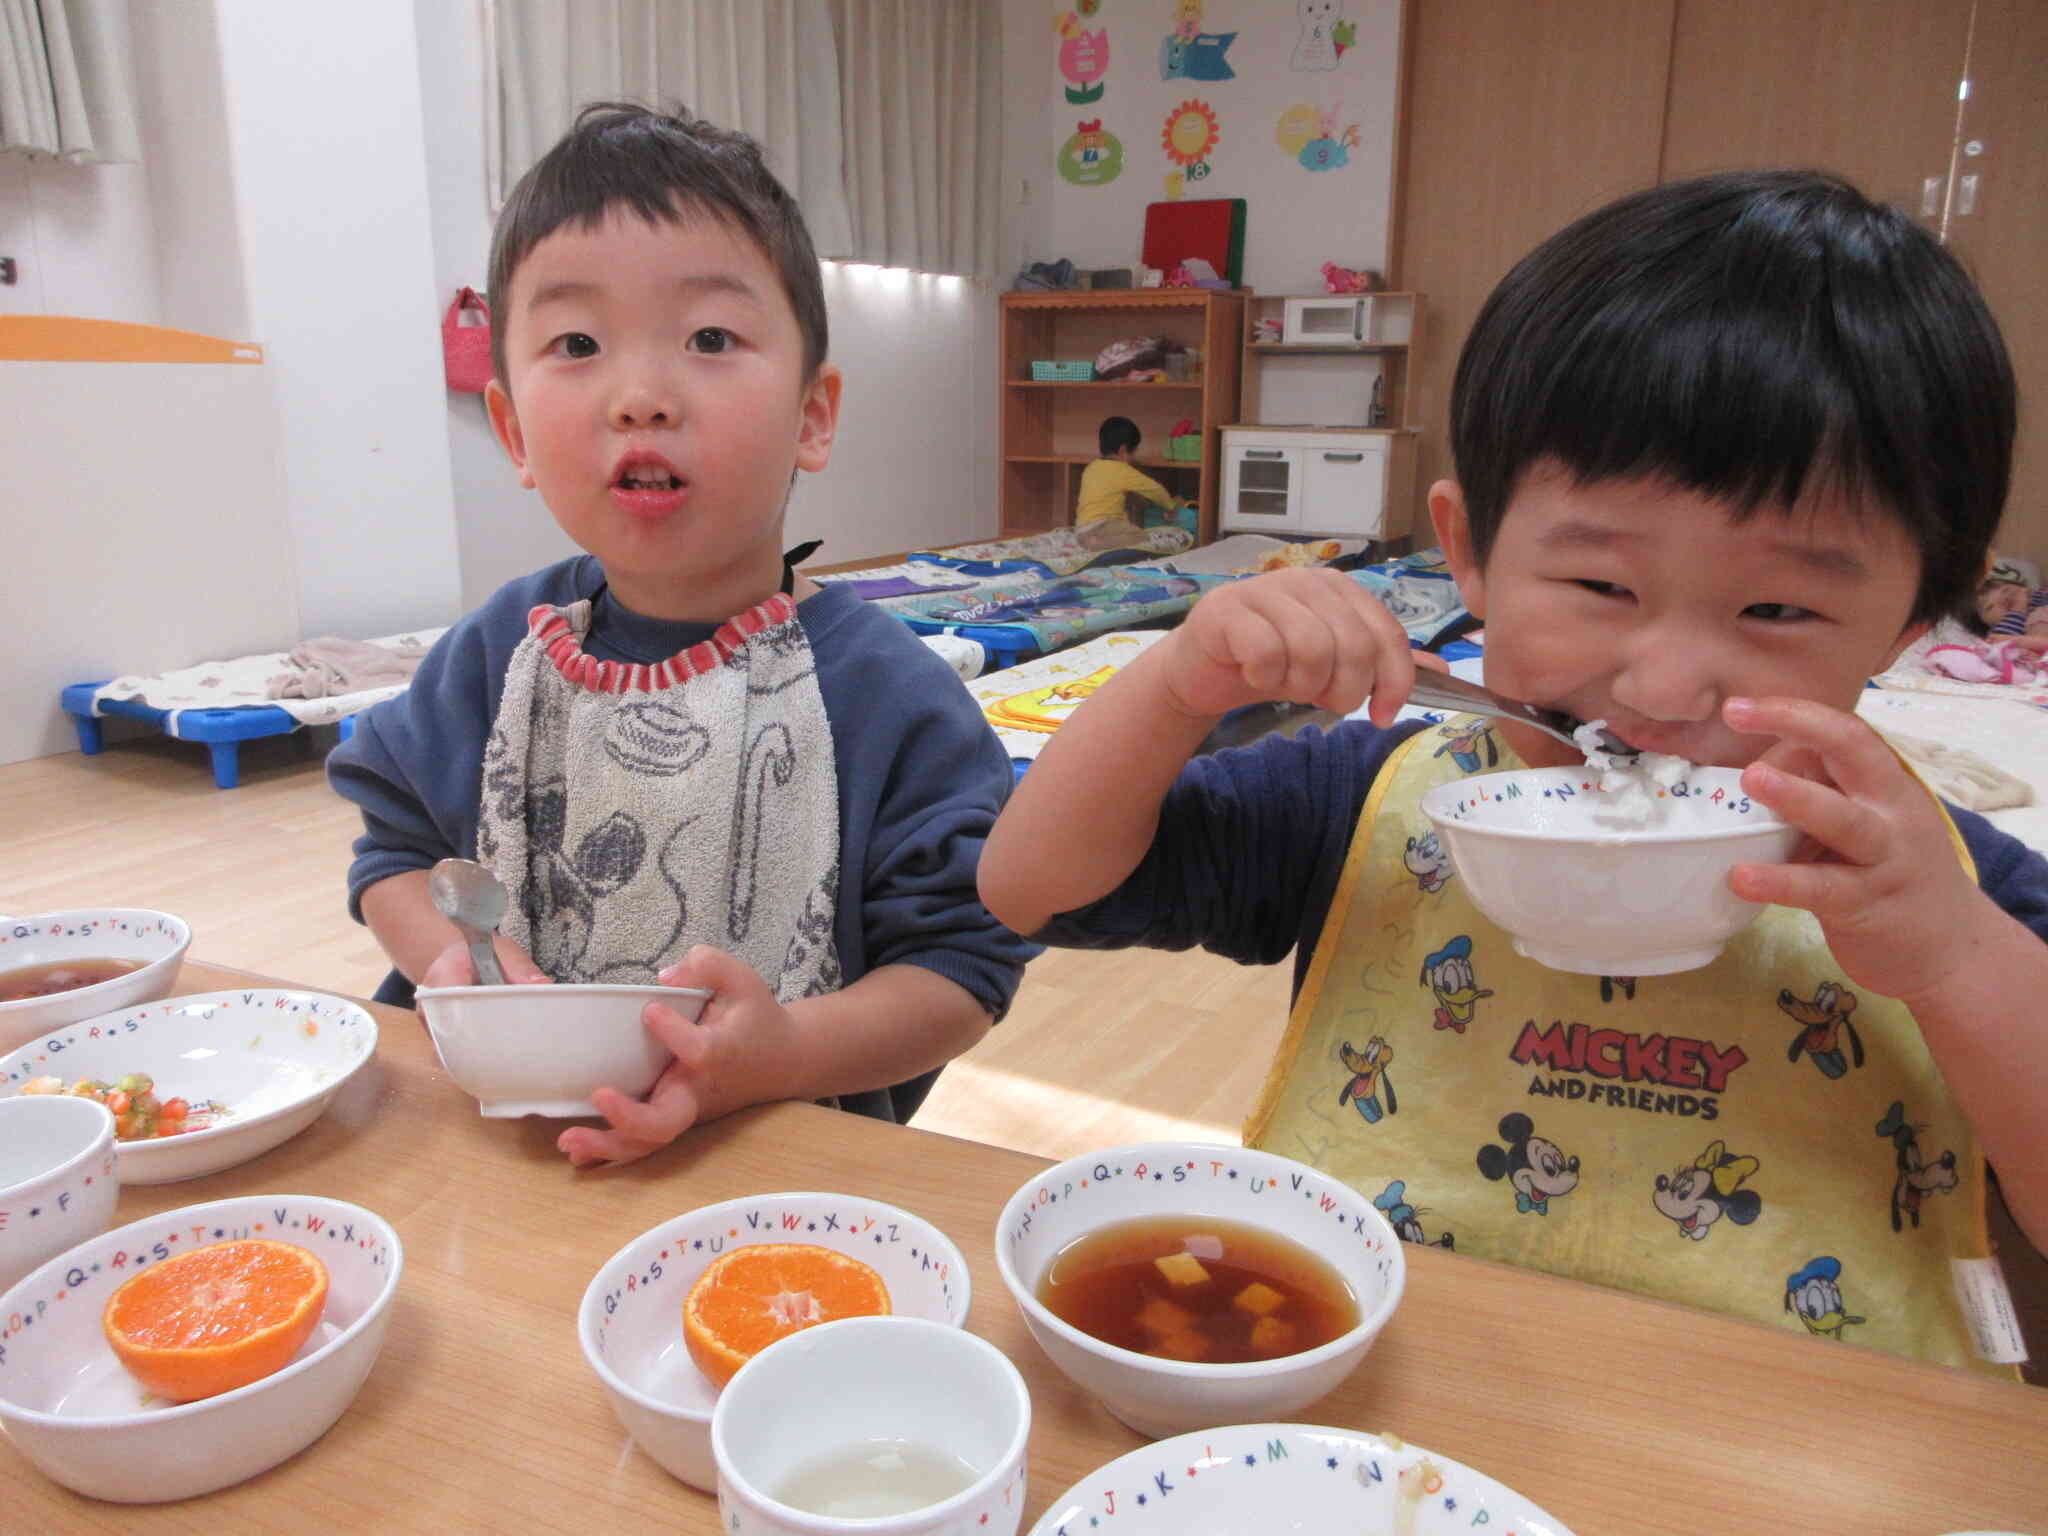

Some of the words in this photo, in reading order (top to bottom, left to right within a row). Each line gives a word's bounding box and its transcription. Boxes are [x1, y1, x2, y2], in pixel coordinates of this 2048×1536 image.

[1477, 784, 1489, 801] L
[1506, 782, 1523, 800] M
[1556, 784, 1576, 802] N
[1671, 781, 1689, 798] Q
[1710, 787, 1725, 804] R
[1739, 797, 1750, 814] S
[13, 926, 31, 938] Q
[50, 924, 64, 936] R
[81, 925, 92, 936] S
[109, 919, 120, 930] T
[135, 928, 145, 938] U
[47, 1040, 65, 1052] Q
[89, 1026, 102, 1039] R
[126, 1019, 138, 1032] S
[162, 1006, 174, 1017] T
[243, 994, 253, 1005] V
[275, 997, 289, 1009] W
[1510, 1019, 1748, 1093] MICKEY
[1527, 1075, 1587, 1099] AND
[1588, 1083, 1720, 1121] FRIENDS
[58, 1191, 71, 1212] F
[1039, 1187, 1049, 1205] O
[1064, 1183, 1073, 1199] P
[1094, 1164, 1112, 1182] Q
[1134, 1162, 1148, 1181] R
[1173, 1166, 1187, 1183] S
[1209, 1161, 1224, 1177] T
[1250, 1178, 1265, 1194] U
[1291, 1173, 1304, 1192] V
[1320, 1191, 1337, 1213] W
[1354, 1216, 1365, 1236] X
[9, 1313, 22, 1333] O
[36, 1300, 46, 1319] P
[66, 1268, 88, 1288] Q
[112, 1250, 128, 1270] R
[153, 1243, 170, 1262] S
[191, 1226, 206, 1243] T
[273, 1208, 287, 1226] V
[307, 1213, 326, 1233] W
[344, 1224, 355, 1243] X
[605, 1295, 618, 1315] Q
[627, 1274, 637, 1293] R
[650, 1263, 662, 1280] S
[675, 1239, 688, 1255] T
[710, 1236, 725, 1253] U
[747, 1211, 761, 1230] V
[782, 1214, 802, 1230] W
[825, 1212, 841, 1232] X
[863, 1215, 877, 1232] Y
[887, 1224, 902, 1242] Z
[921, 1252, 931, 1272] A
[1103, 1489, 1115, 1515] J
[1154, 1470, 1175, 1496] K
[1267, 1438, 1290, 1463] M
[1423, 1470, 1443, 1495] O
[1471, 1508, 1490, 1528] P
